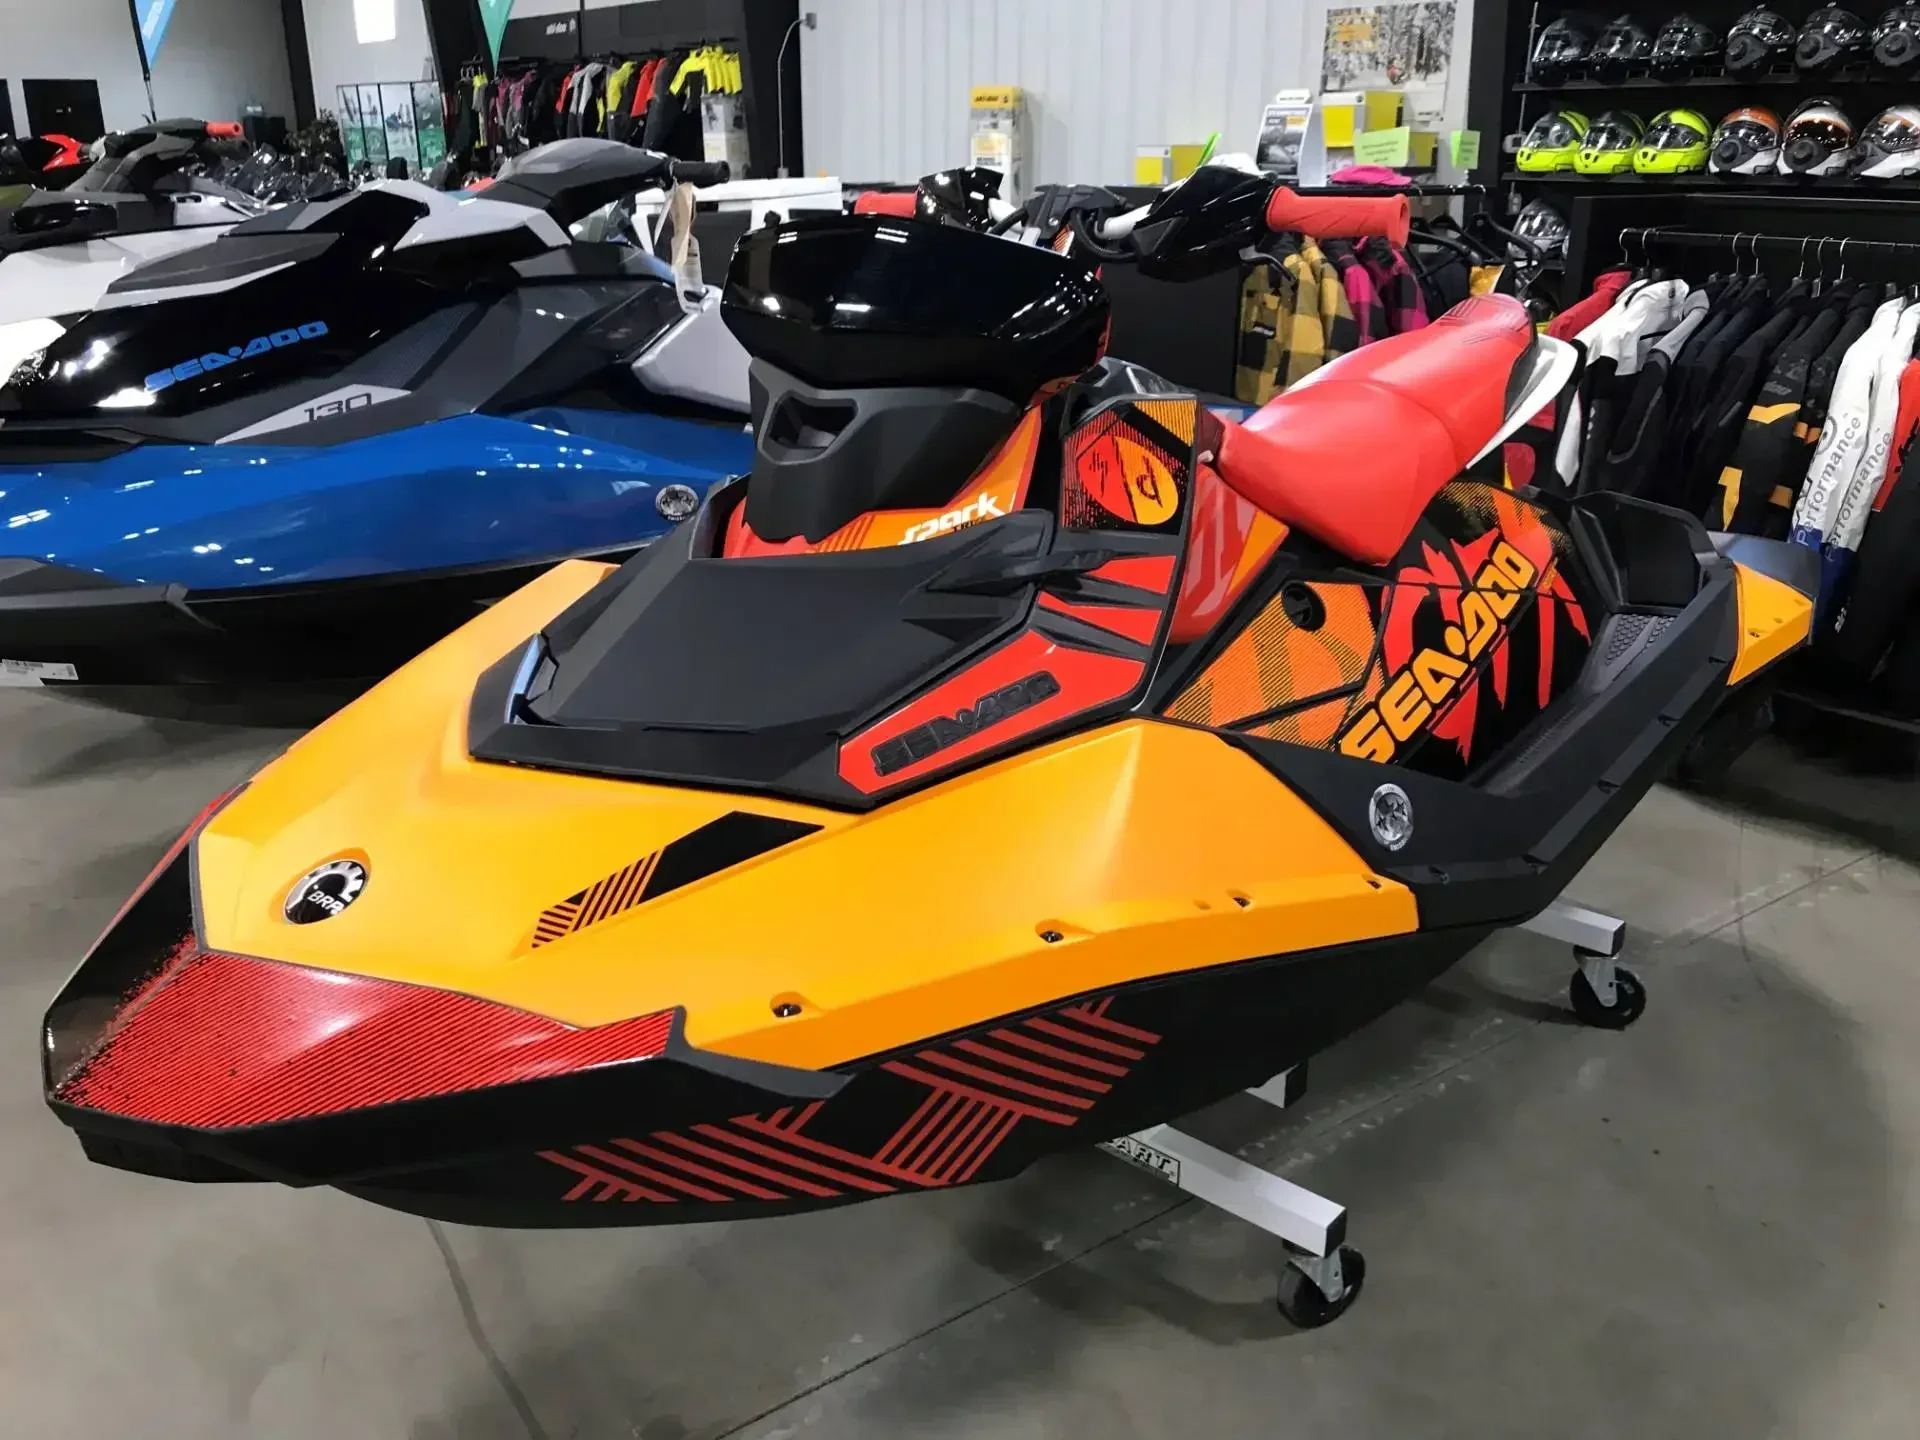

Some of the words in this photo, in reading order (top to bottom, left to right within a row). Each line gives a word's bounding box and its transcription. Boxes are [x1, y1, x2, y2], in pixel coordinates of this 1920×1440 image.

[303, 392, 372, 422] 130
[1796, 416, 1861, 546] Performance
[307, 890, 345, 915] BRP
